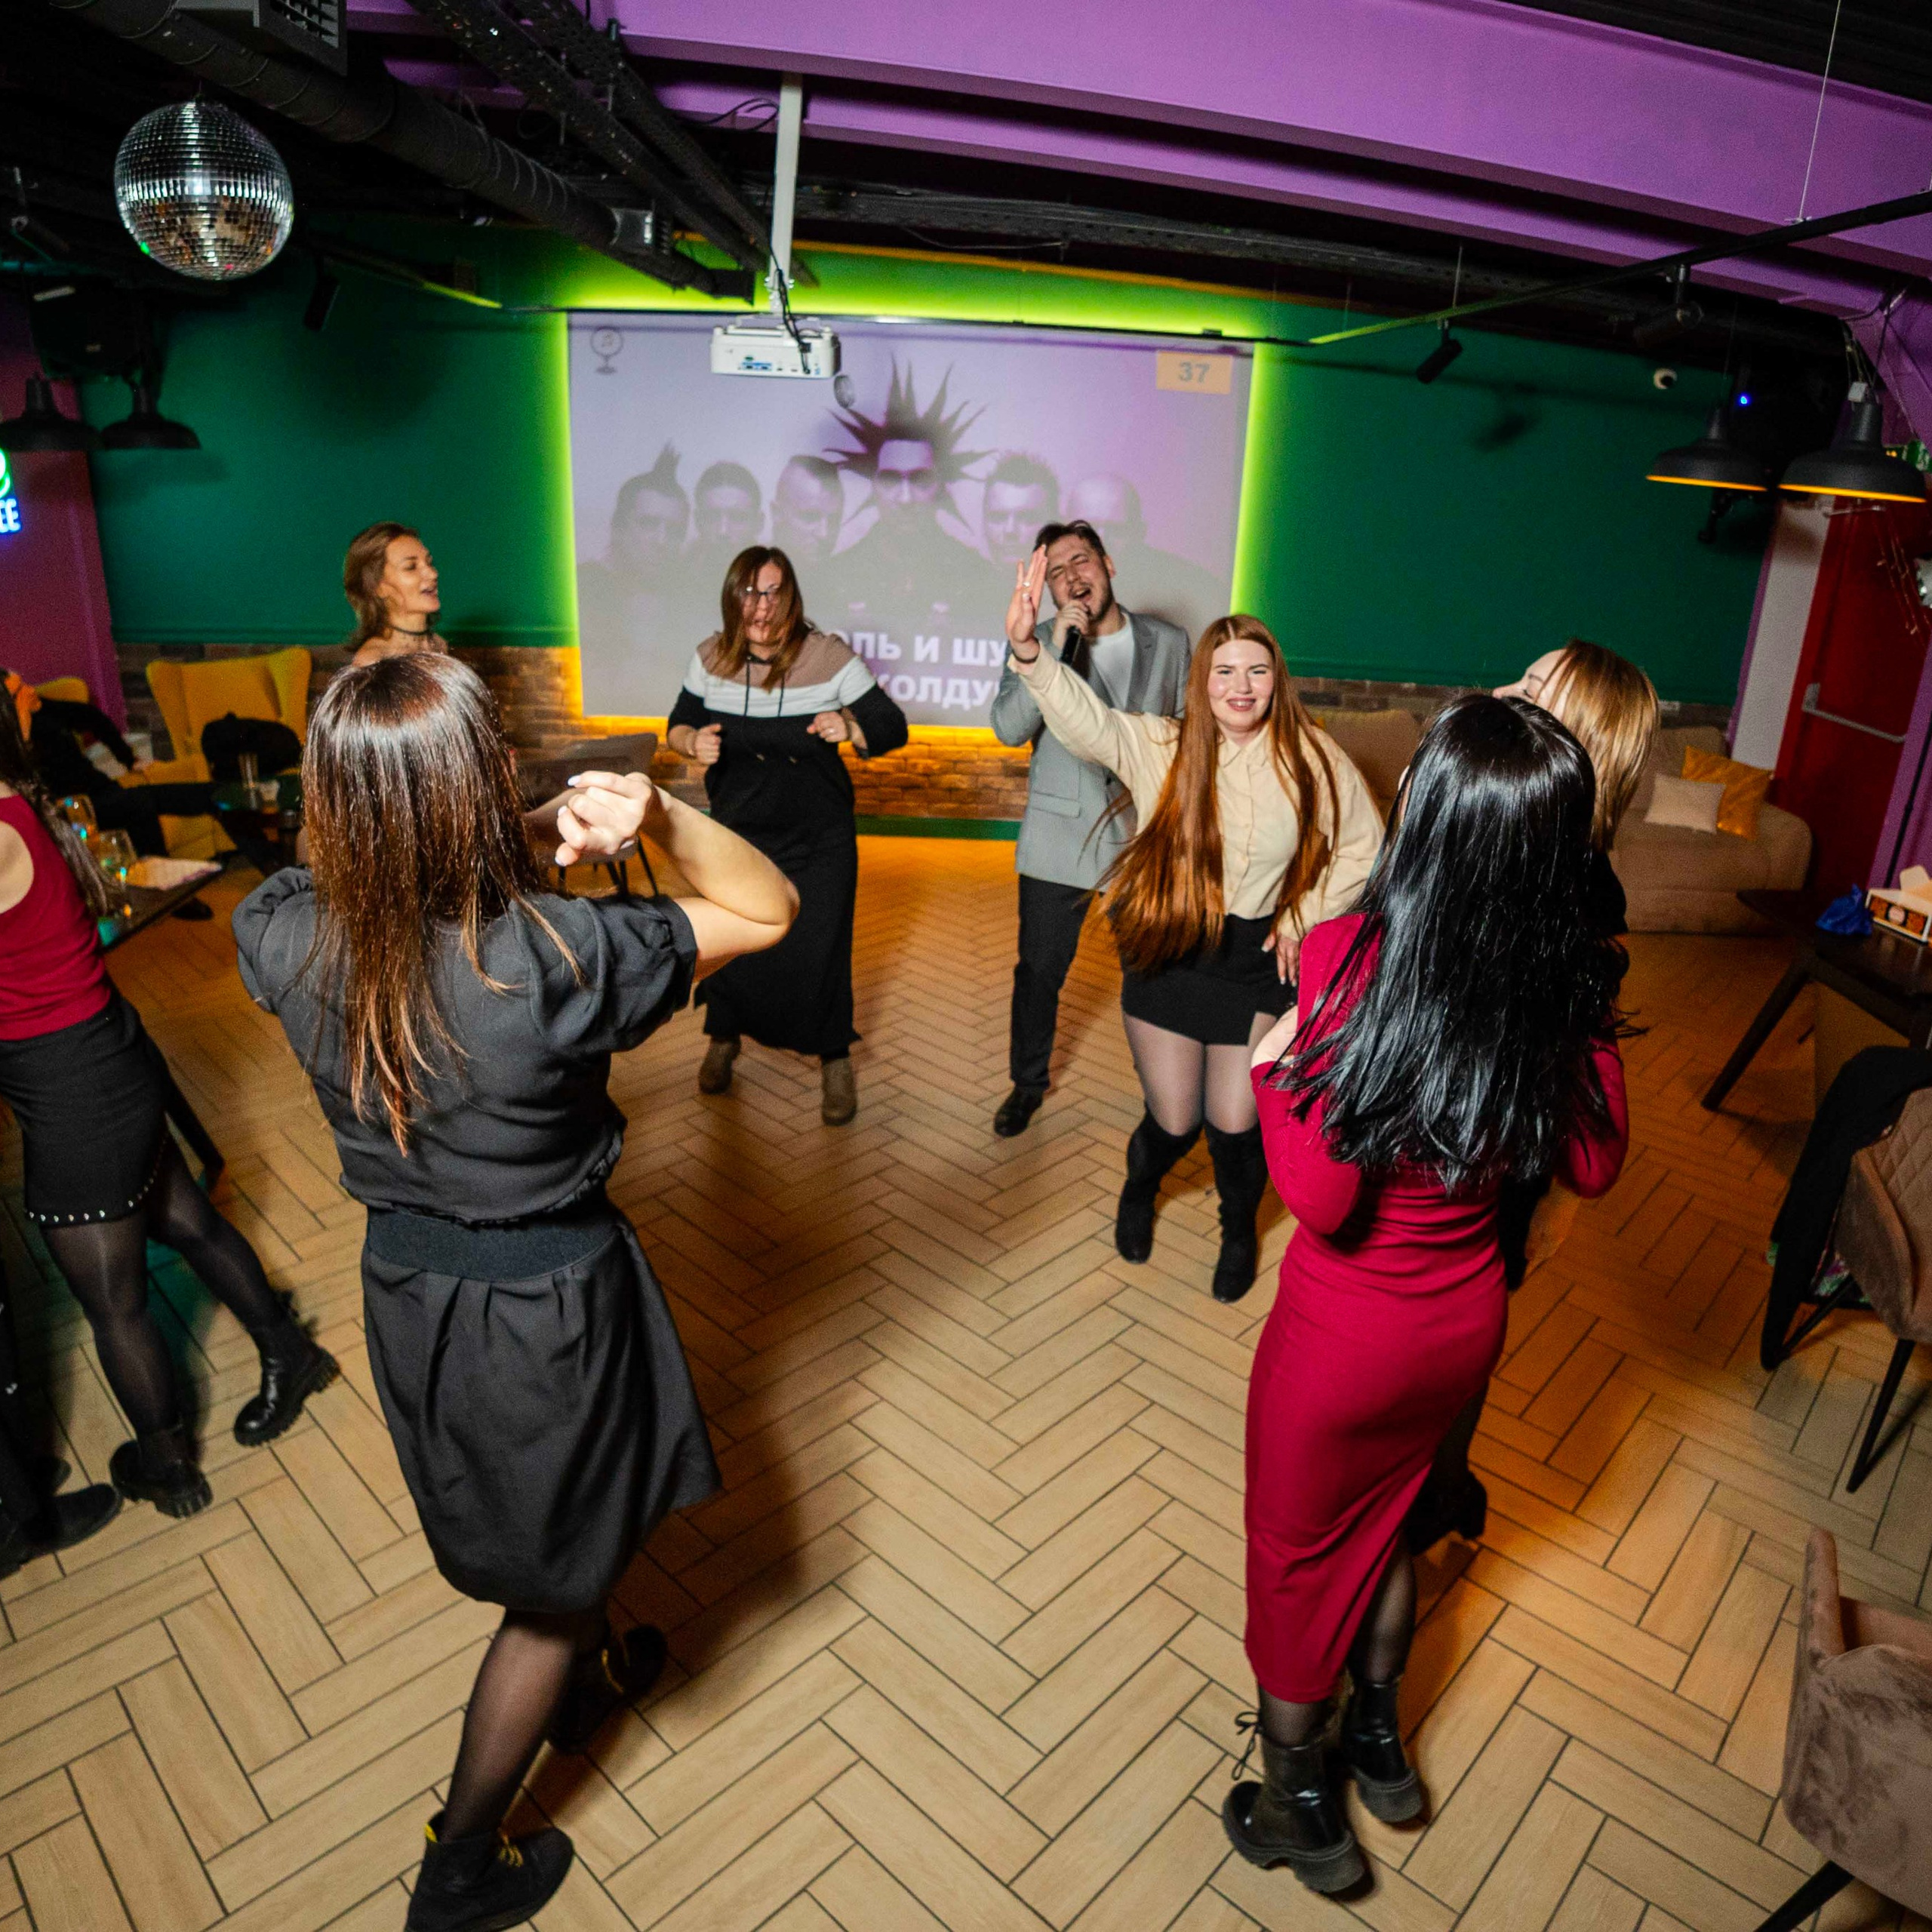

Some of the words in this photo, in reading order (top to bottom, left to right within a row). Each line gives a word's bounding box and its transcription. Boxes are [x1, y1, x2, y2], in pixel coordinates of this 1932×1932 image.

[1178, 361, 1211, 383] 37
[825, 629, 902, 660] ЛЬ
[913, 634, 940, 663] И
[952, 638, 1007, 667] ШУ
[877, 674, 1001, 711] ОЛДУ
